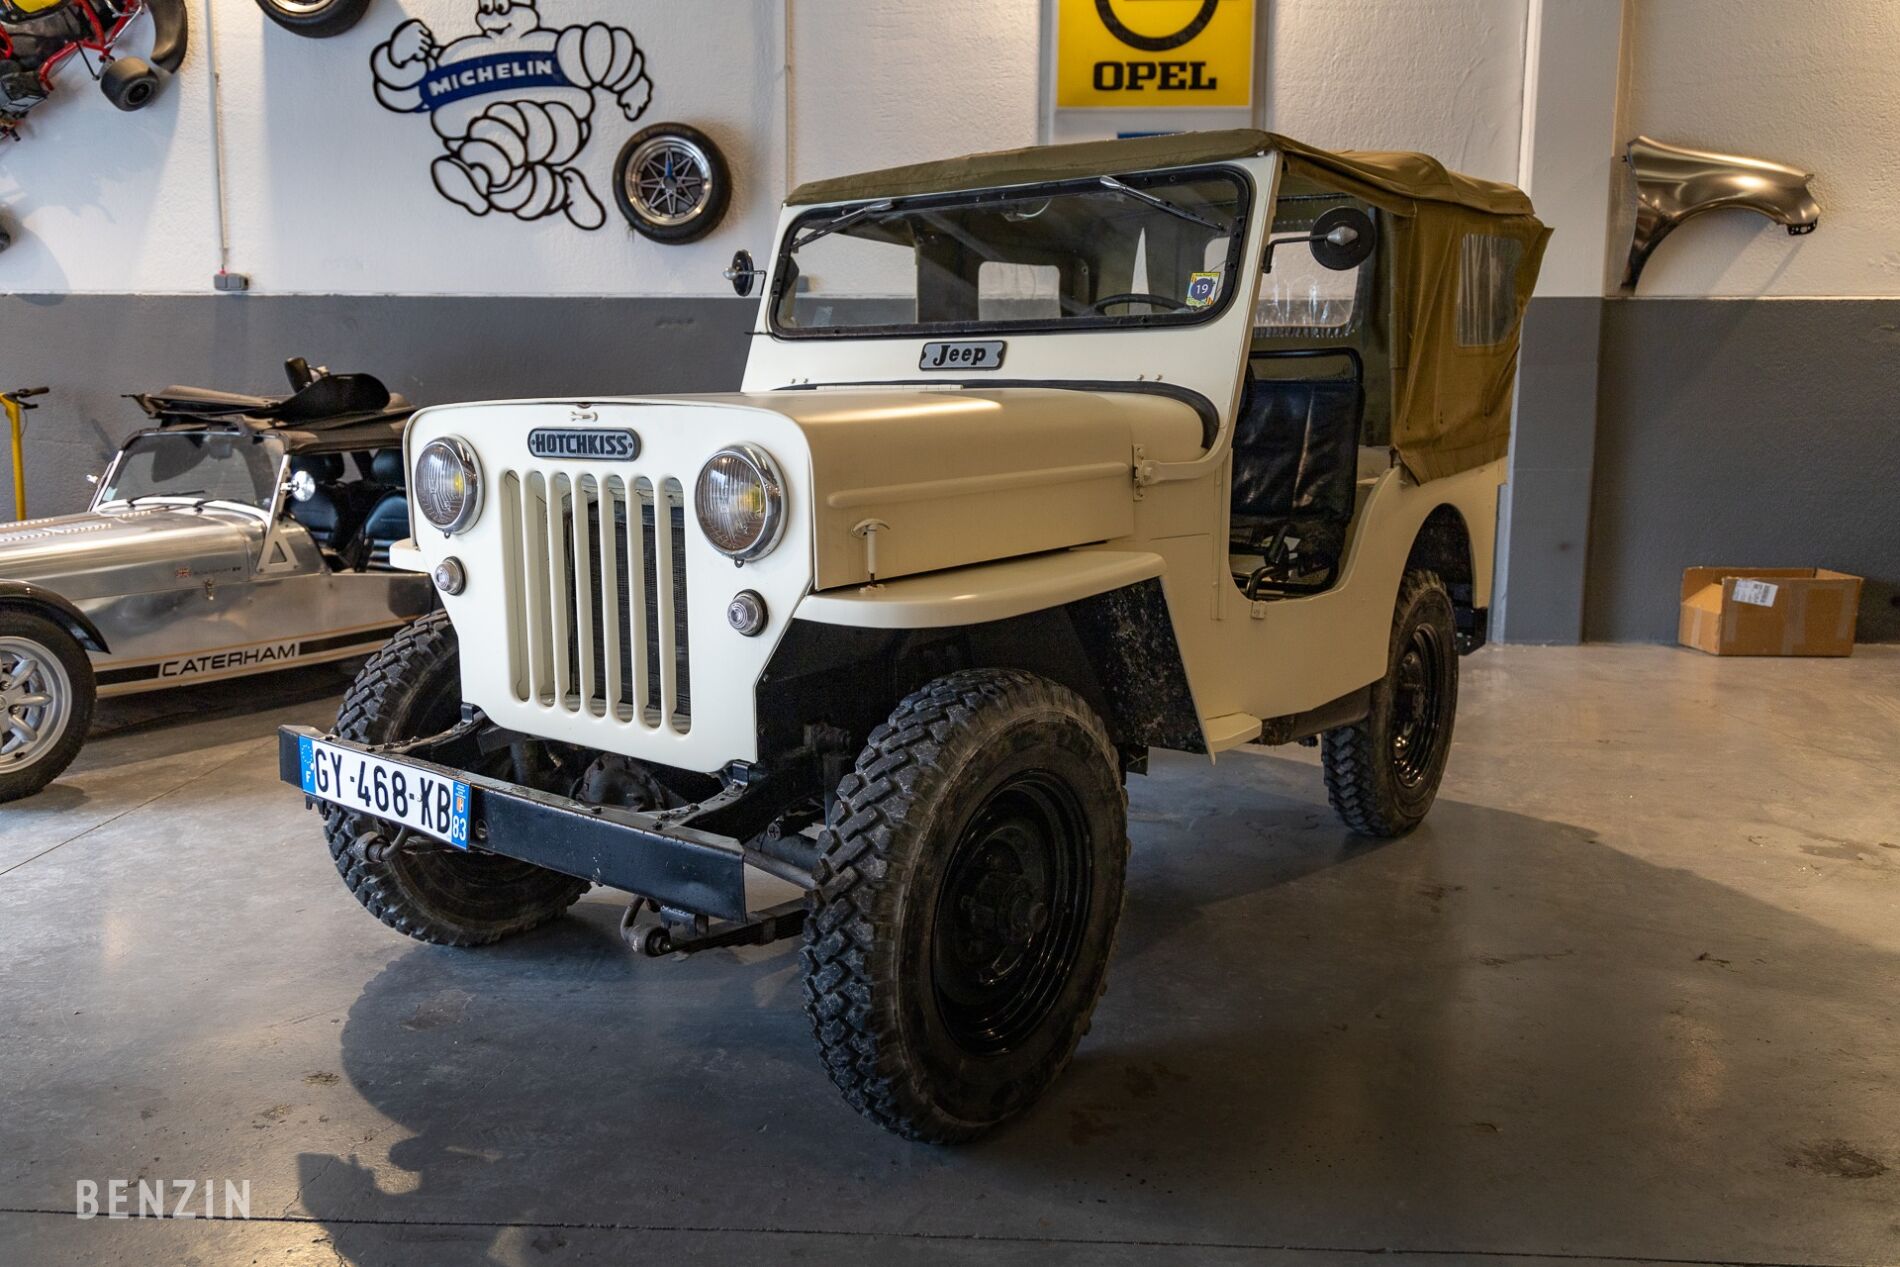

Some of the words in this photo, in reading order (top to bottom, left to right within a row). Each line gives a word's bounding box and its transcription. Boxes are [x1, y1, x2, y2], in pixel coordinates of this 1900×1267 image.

[428, 60, 552, 96] MICHELIN
[1093, 61, 1217, 91] OPEL
[1196, 283, 1209, 294] 19
[932, 345, 986, 366] Jeep
[535, 433, 628, 455] HOTCHKISS
[162, 643, 296, 677] CATERHAM
[305, 771, 311, 783] F
[452, 815, 467, 841] 83
